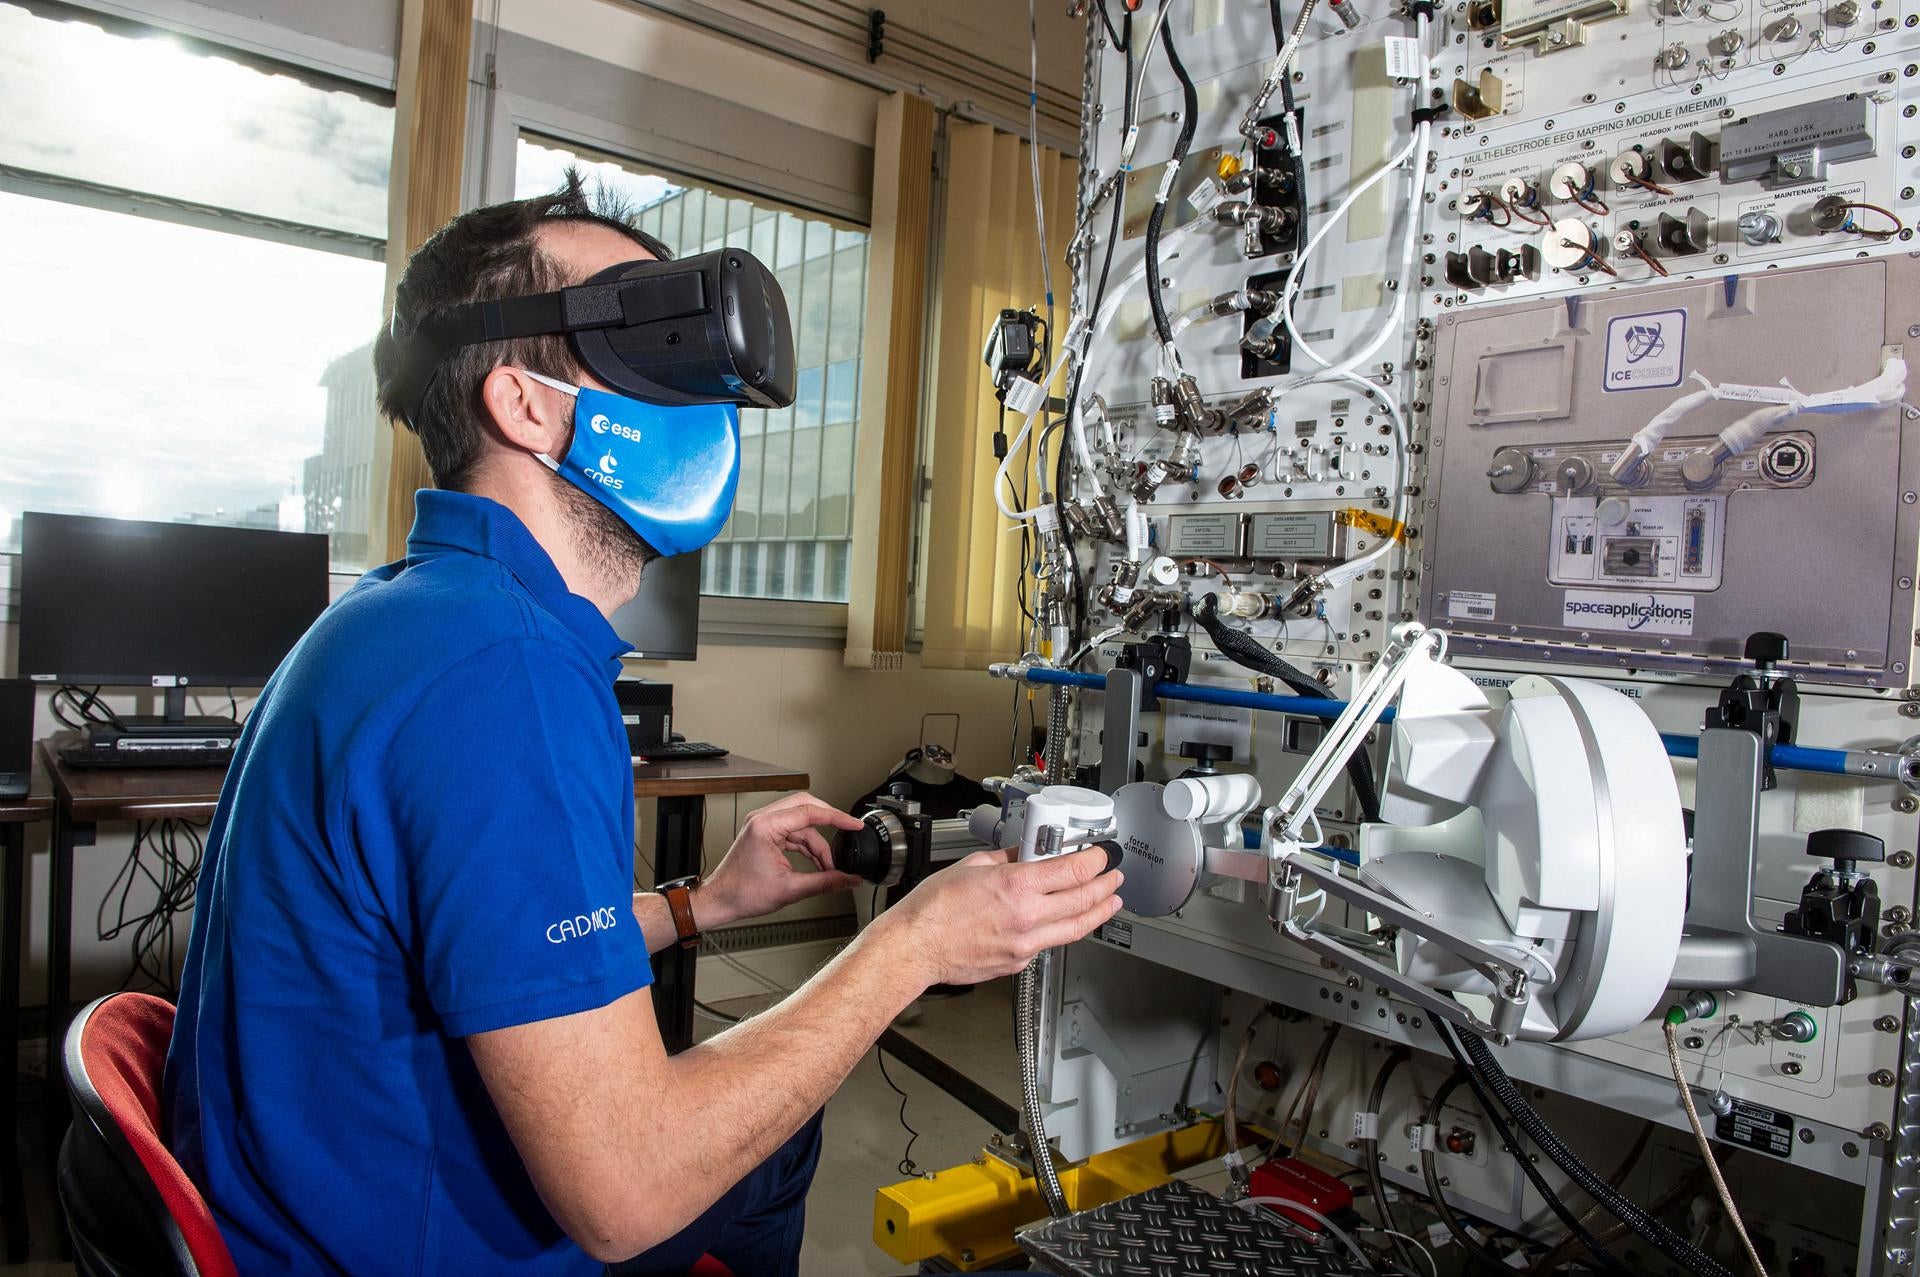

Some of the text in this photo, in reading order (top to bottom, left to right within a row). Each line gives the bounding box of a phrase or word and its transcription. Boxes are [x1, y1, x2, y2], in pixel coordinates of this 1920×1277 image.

[1774, 6, 1789, 14] USB
[1488, 55, 1508, 64] POWER
[1464, 96, 1727, 165] MULTI-ELECTRODE EEG MAPPING MODULE (MEEMM)
[1640, 121, 1699, 138] HEADBOX POWER
[1768, 124, 1814, 139] HARD DISK
[1823, 128, 1842, 137] POWER
[1856, 123, 1865, 131] ON
[1556, 149, 1602, 164] HEADBOX DATA
[1478, 165, 1530, 181] EXTERNAL INPUTS
[1774, 185, 1827, 200] MAINTENANCE
[1828, 188, 1861, 198] DOWNLOAD
[1639, 194, 1694, 210] CAMERA POWER
[611, 423, 642, 442] esa
[584, 468, 624, 490] cnes
[1566, 601, 1692, 620] spaceapplications
[1130, 835, 1149, 850] force
[1124, 842, 1164, 865] dimension
[546, 906, 616, 944] CADMOS
[1690, 1027, 1708, 1035] RESET
[1788, 1051, 1806, 1060] RESET
